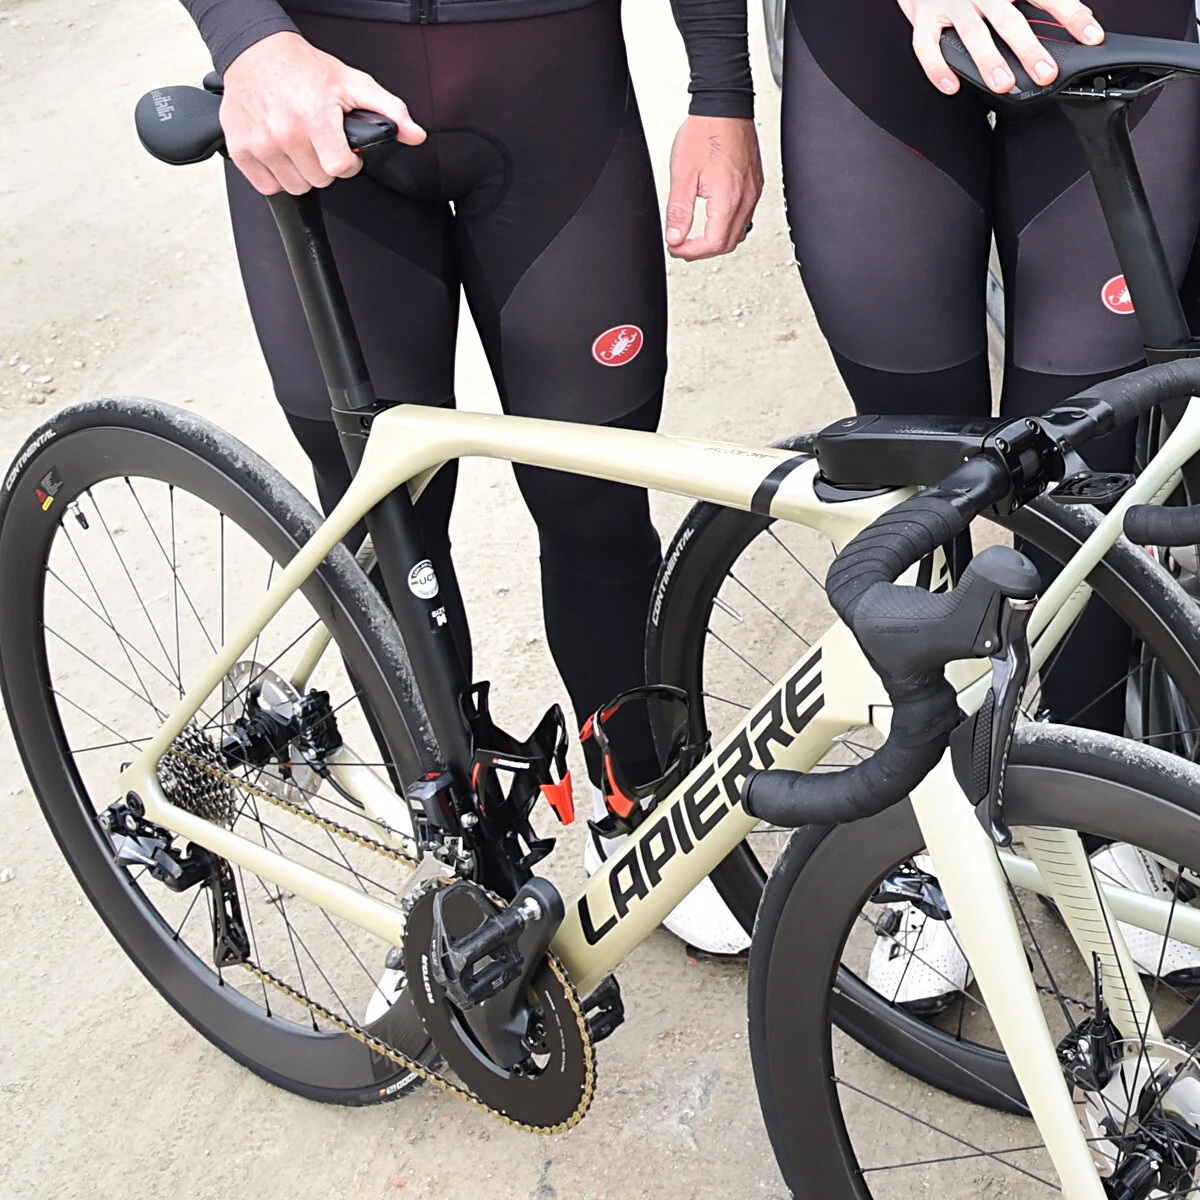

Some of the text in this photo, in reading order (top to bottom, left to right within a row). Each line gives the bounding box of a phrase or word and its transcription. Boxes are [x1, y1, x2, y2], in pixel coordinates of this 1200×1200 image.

[5, 429, 57, 492] CONTINENTAL
[651, 527, 695, 627] CONTINENTAL
[577, 645, 826, 946] LAPIERRE
